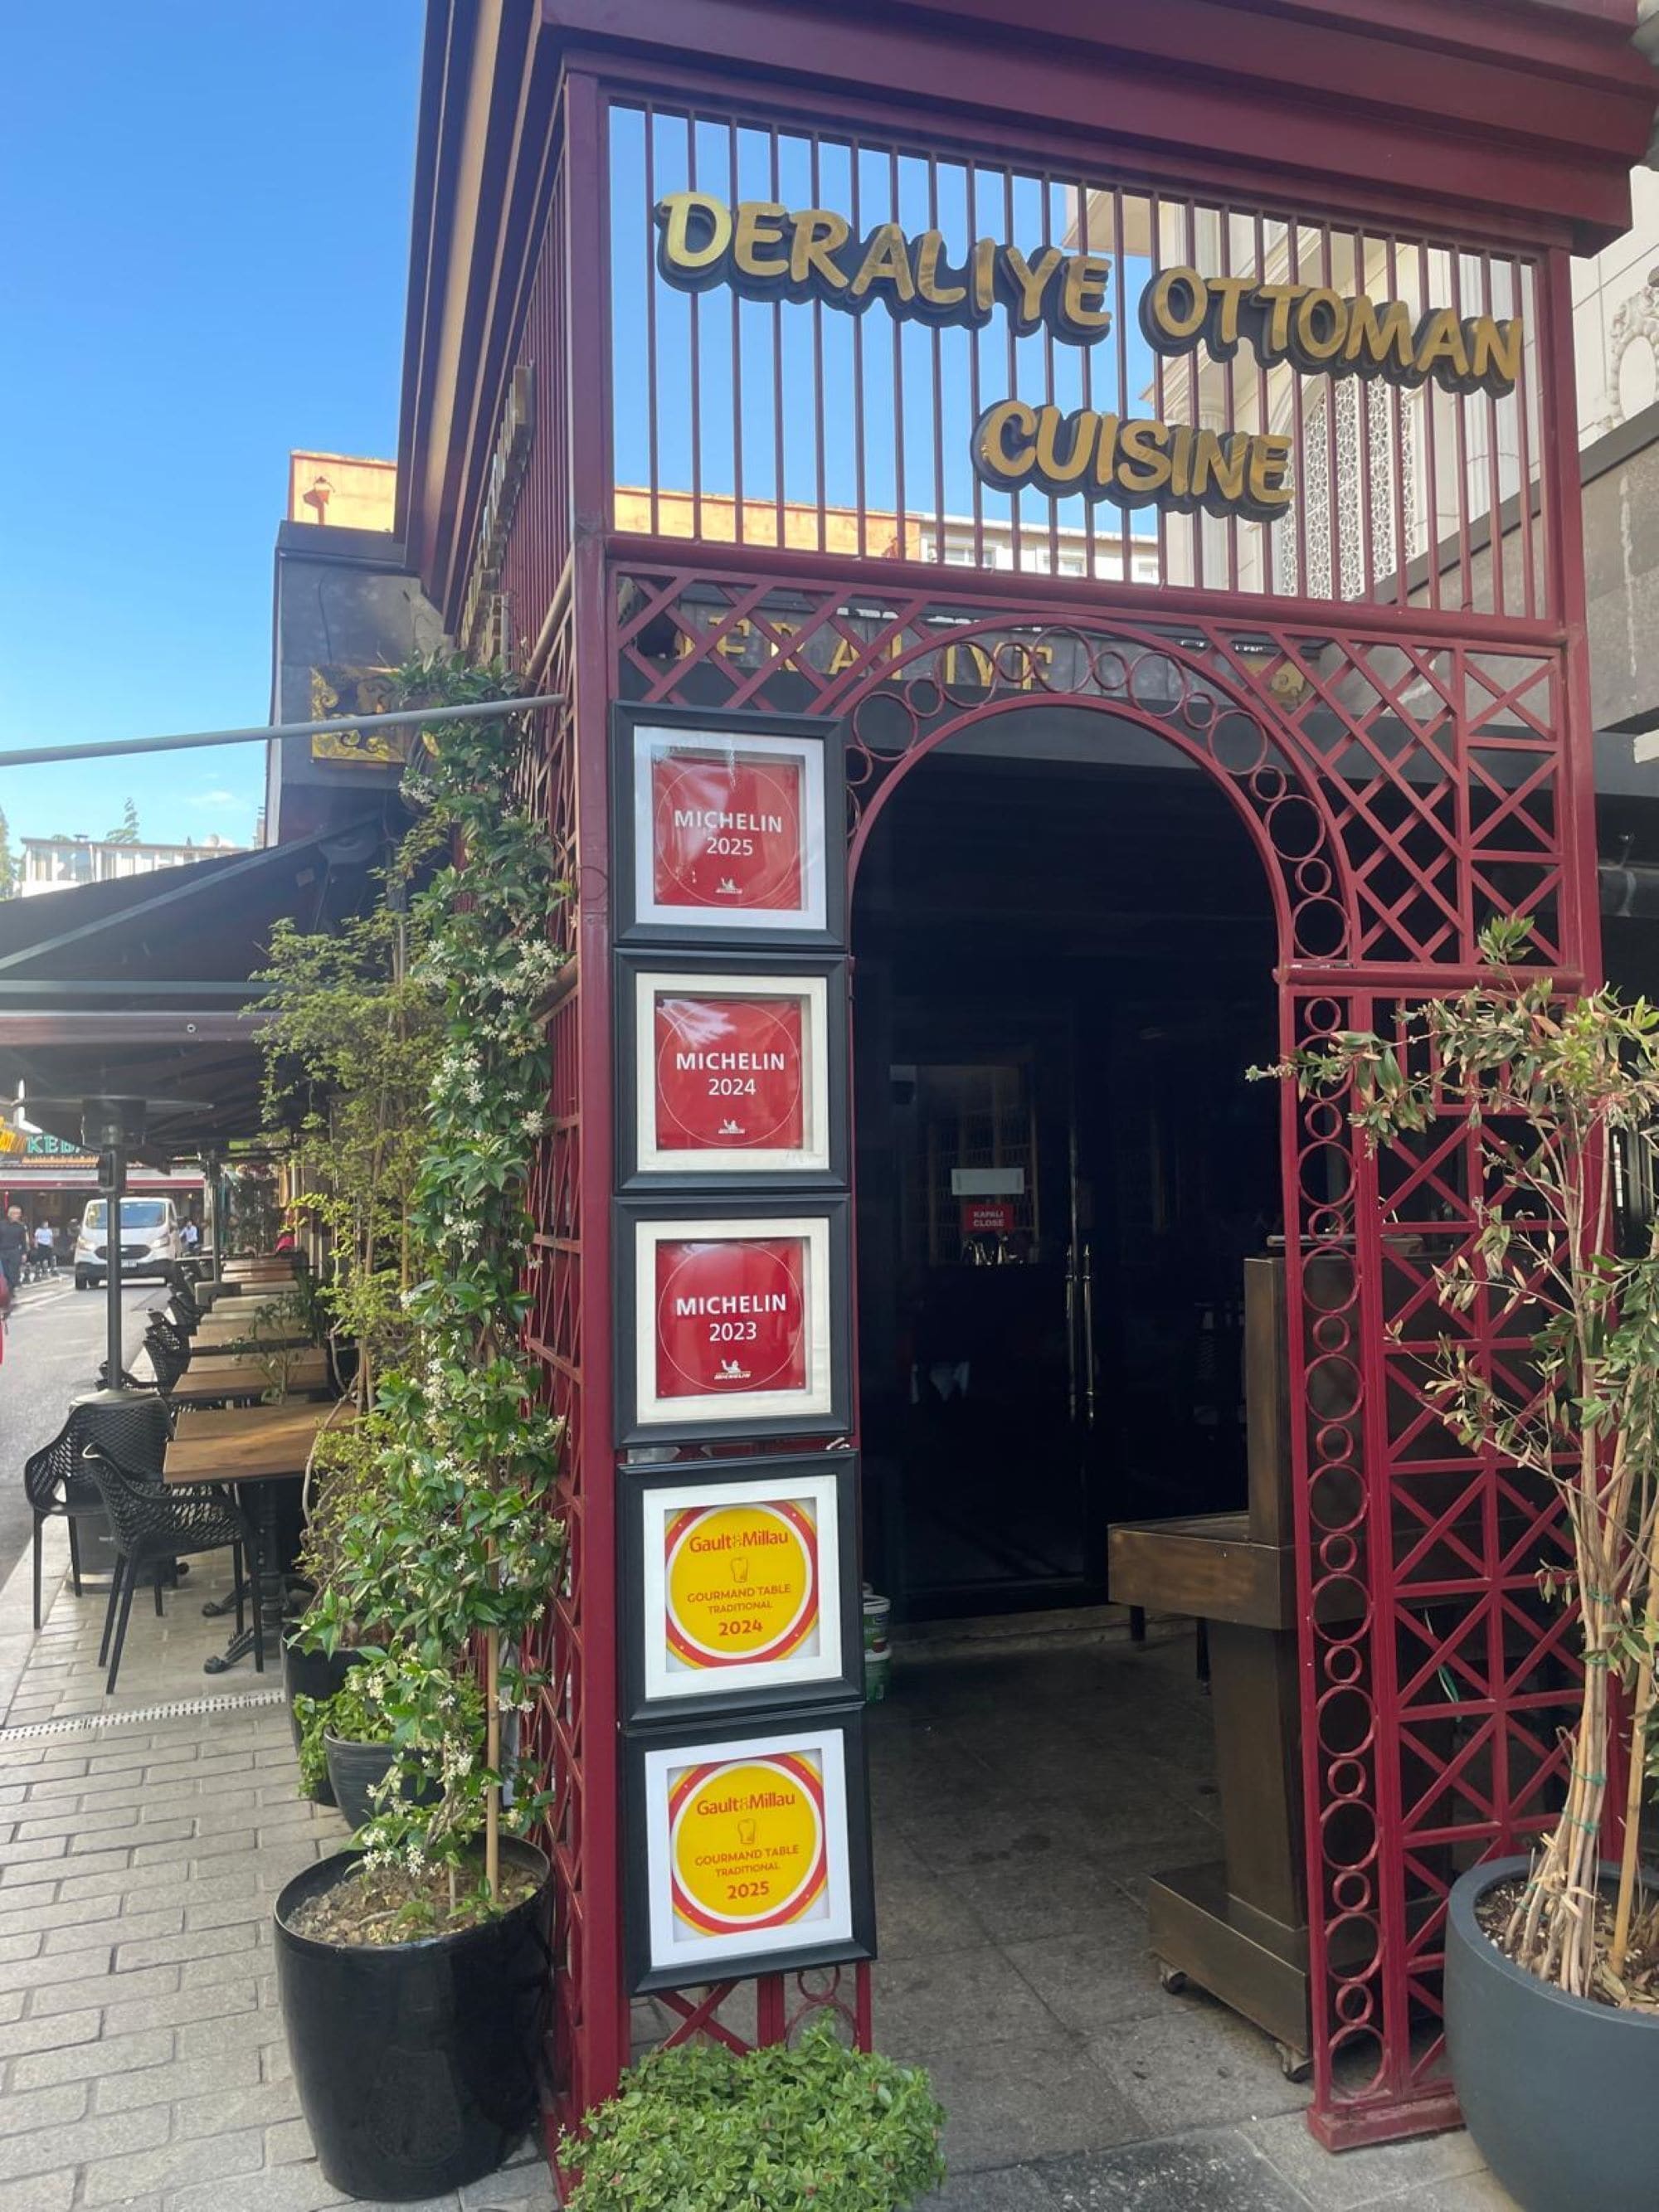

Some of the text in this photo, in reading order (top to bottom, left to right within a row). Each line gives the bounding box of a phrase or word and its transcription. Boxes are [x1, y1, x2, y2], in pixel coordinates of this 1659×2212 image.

[653, 192, 1524, 386] DERALIYE OTTOMAN
[978, 398, 1296, 510] CUISINE
[674, 809, 782, 833] MICHELIN
[706, 837, 753, 856] 2025
[676, 1053, 785, 1070] MICHELIN
[708, 1078, 756, 1096] 2024
[676, 1294, 786, 1315] MICHELIN
[709, 1322, 757, 1342] 2023
[687, 1583, 791, 1602] GOURMAND TABLE
[708, 1601, 772, 1614] TRADITIONAL
[719, 1620, 763, 1636] 2024
[695, 1845, 800, 1866] GOURMAND TABLE
[716, 1862, 780, 1877] TRADITIONAL
[727, 1881, 770, 1899] 2025
